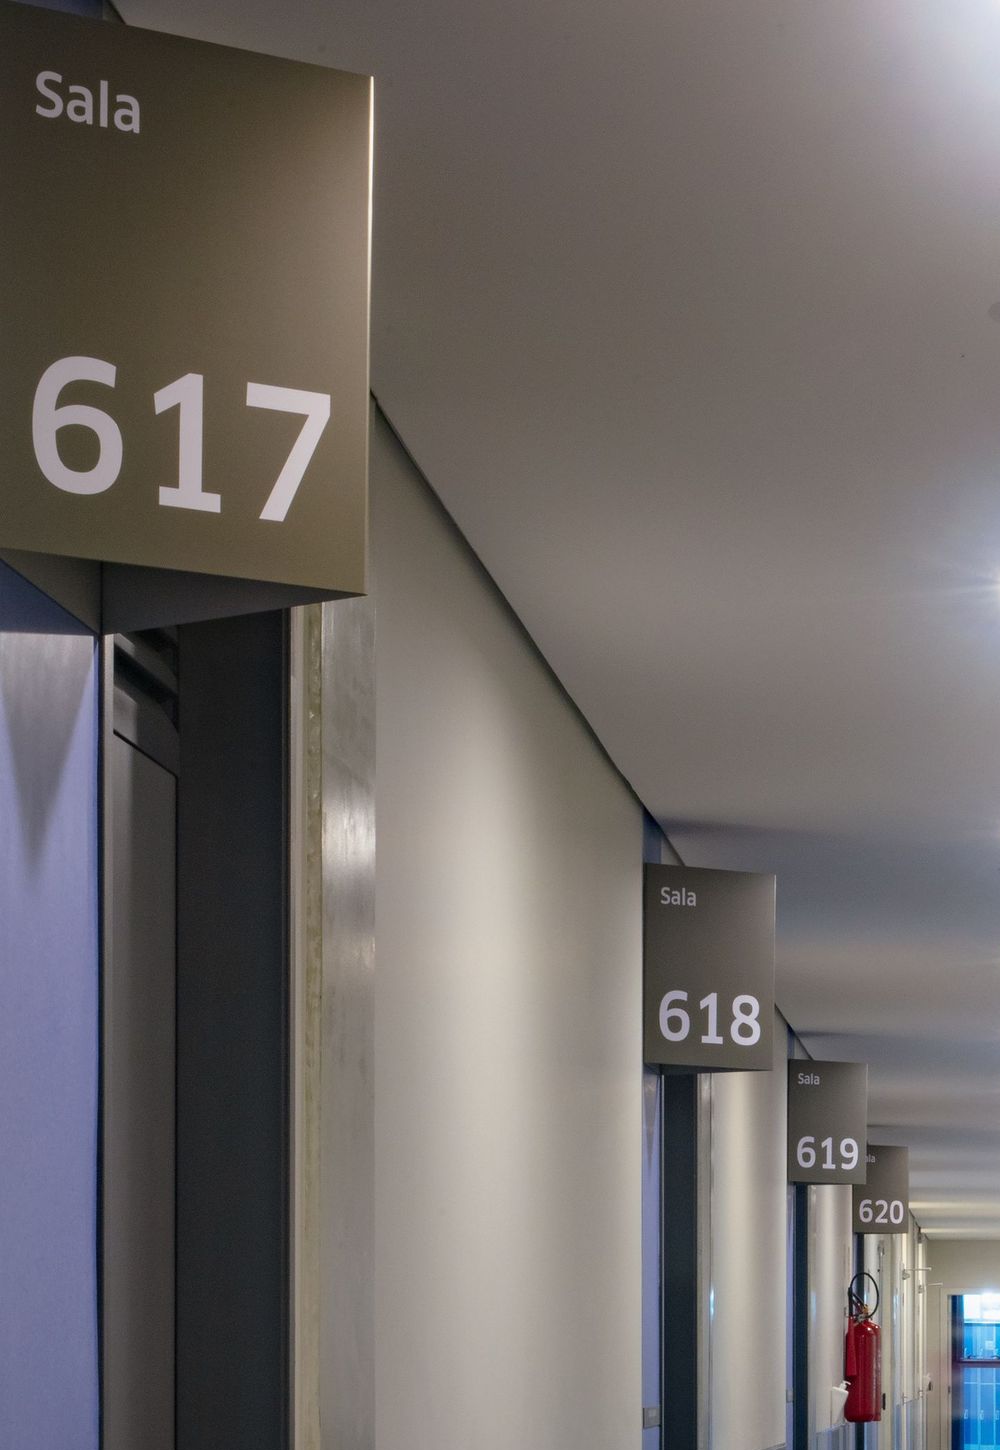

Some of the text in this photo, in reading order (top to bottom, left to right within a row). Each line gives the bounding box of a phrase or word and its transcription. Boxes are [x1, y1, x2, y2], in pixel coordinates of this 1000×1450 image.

[35, 70, 141, 134] Sala
[32, 356, 332, 522] 617
[660, 886, 697, 907] Sala
[659, 990, 761, 1046] 618
[798, 1072, 820, 1085] Sala
[797, 1136, 859, 1170] 619
[859, 1199, 904, 1225] 620
